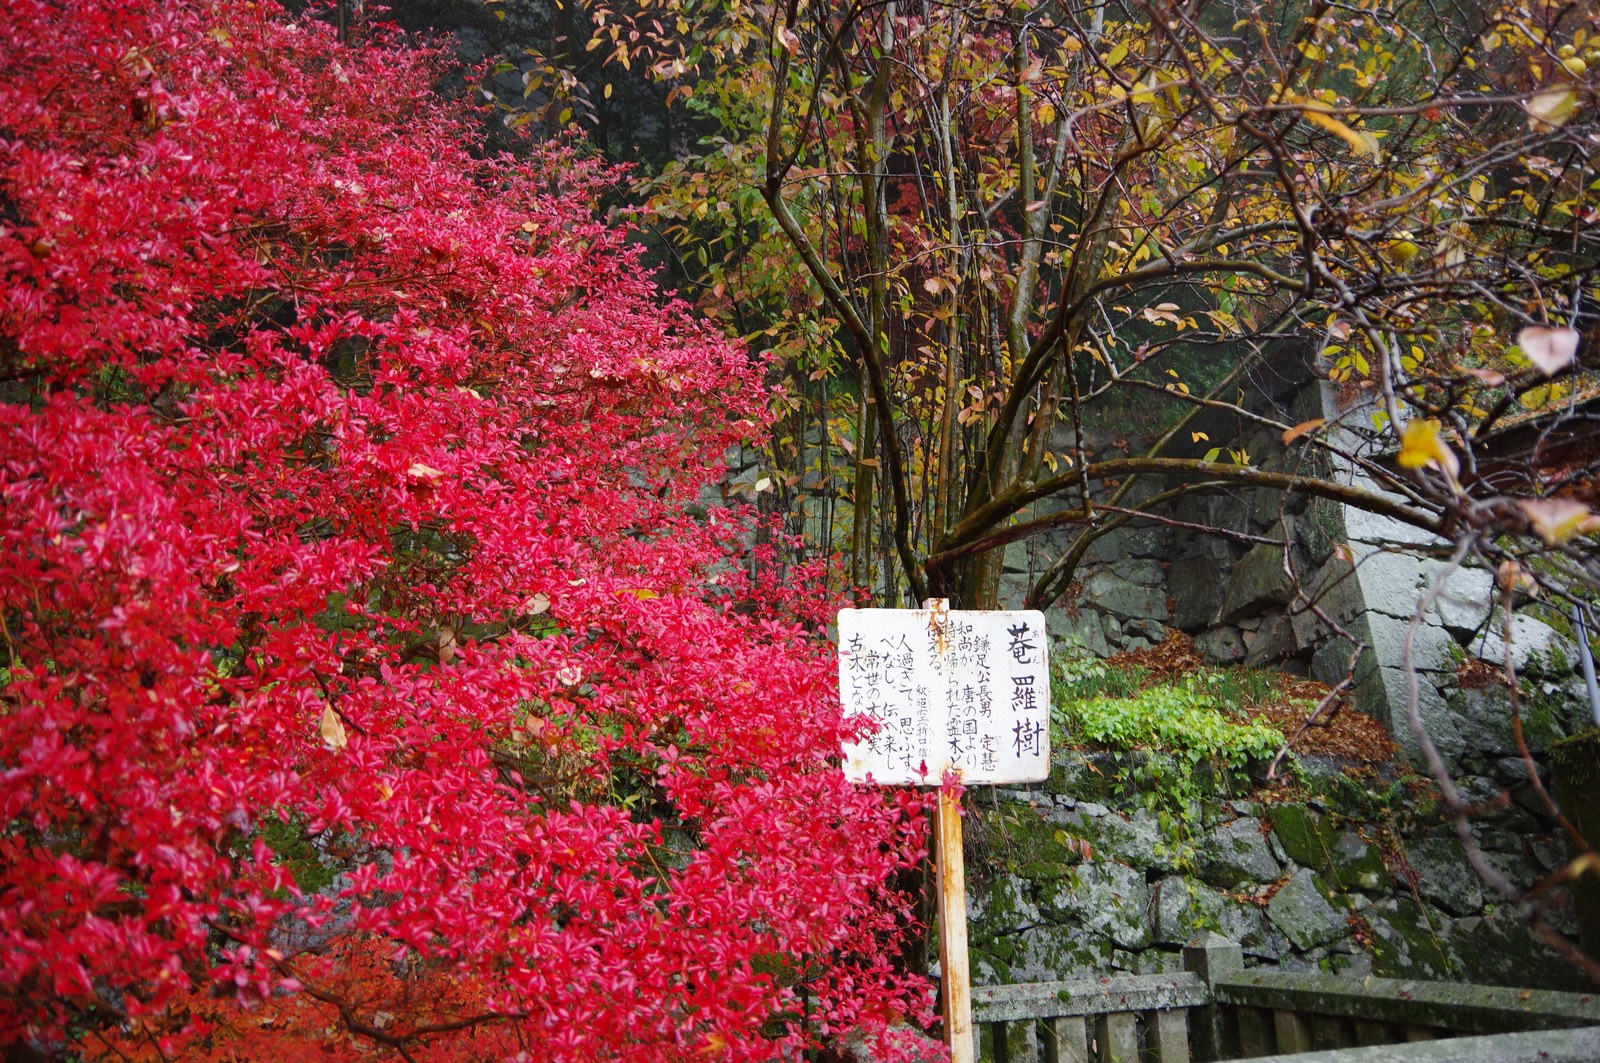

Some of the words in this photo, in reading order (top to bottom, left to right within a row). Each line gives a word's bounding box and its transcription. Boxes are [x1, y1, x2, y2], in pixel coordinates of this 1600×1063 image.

[864, 649, 882, 755] 常世の木実
[1006, 621, 1045, 758] 菴羅樹
